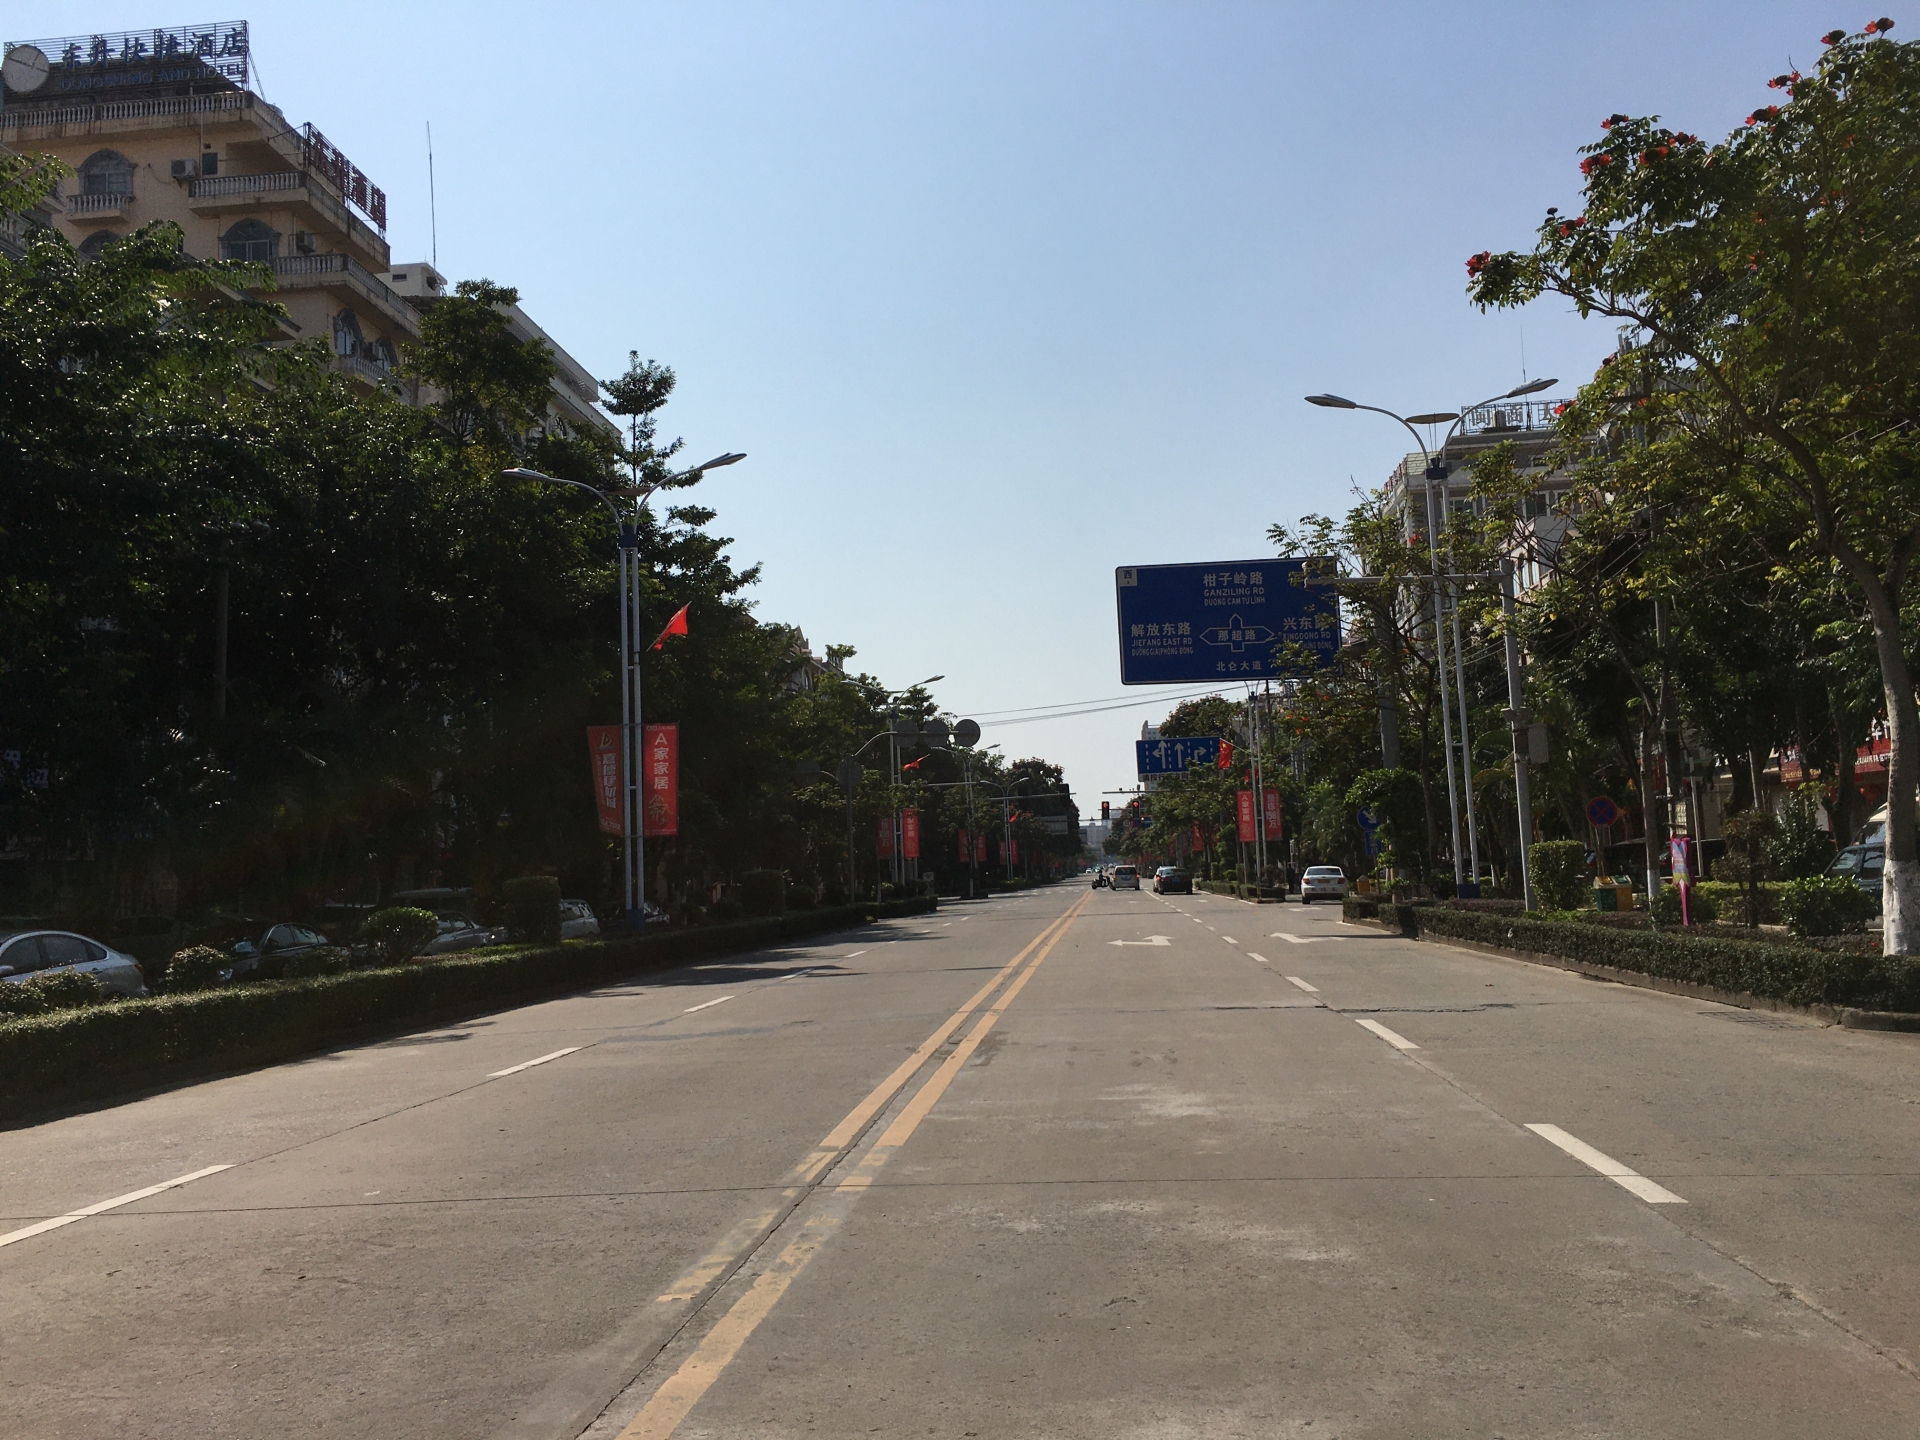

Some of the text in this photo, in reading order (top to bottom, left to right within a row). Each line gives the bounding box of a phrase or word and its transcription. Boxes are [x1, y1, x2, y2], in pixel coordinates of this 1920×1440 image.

[158, 66, 191, 83] AND
[195, 62, 243, 79] HOTEL
[1122, 569, 1133, 580] 西
[1203, 571, 1263, 587] 柑子岭路
[1203, 586, 1265, 597] GANZILING RD
[1131, 621, 1191, 637] 解放东路
[1217, 629, 1256, 641] 那超路
[1283, 631, 1331, 641] XINGDONG RD
[1131, 637, 1193, 647] JIEFANG EAST RD
[1216, 660, 1262, 671] 北仑大道
[654, 732, 669, 790] A家家居
